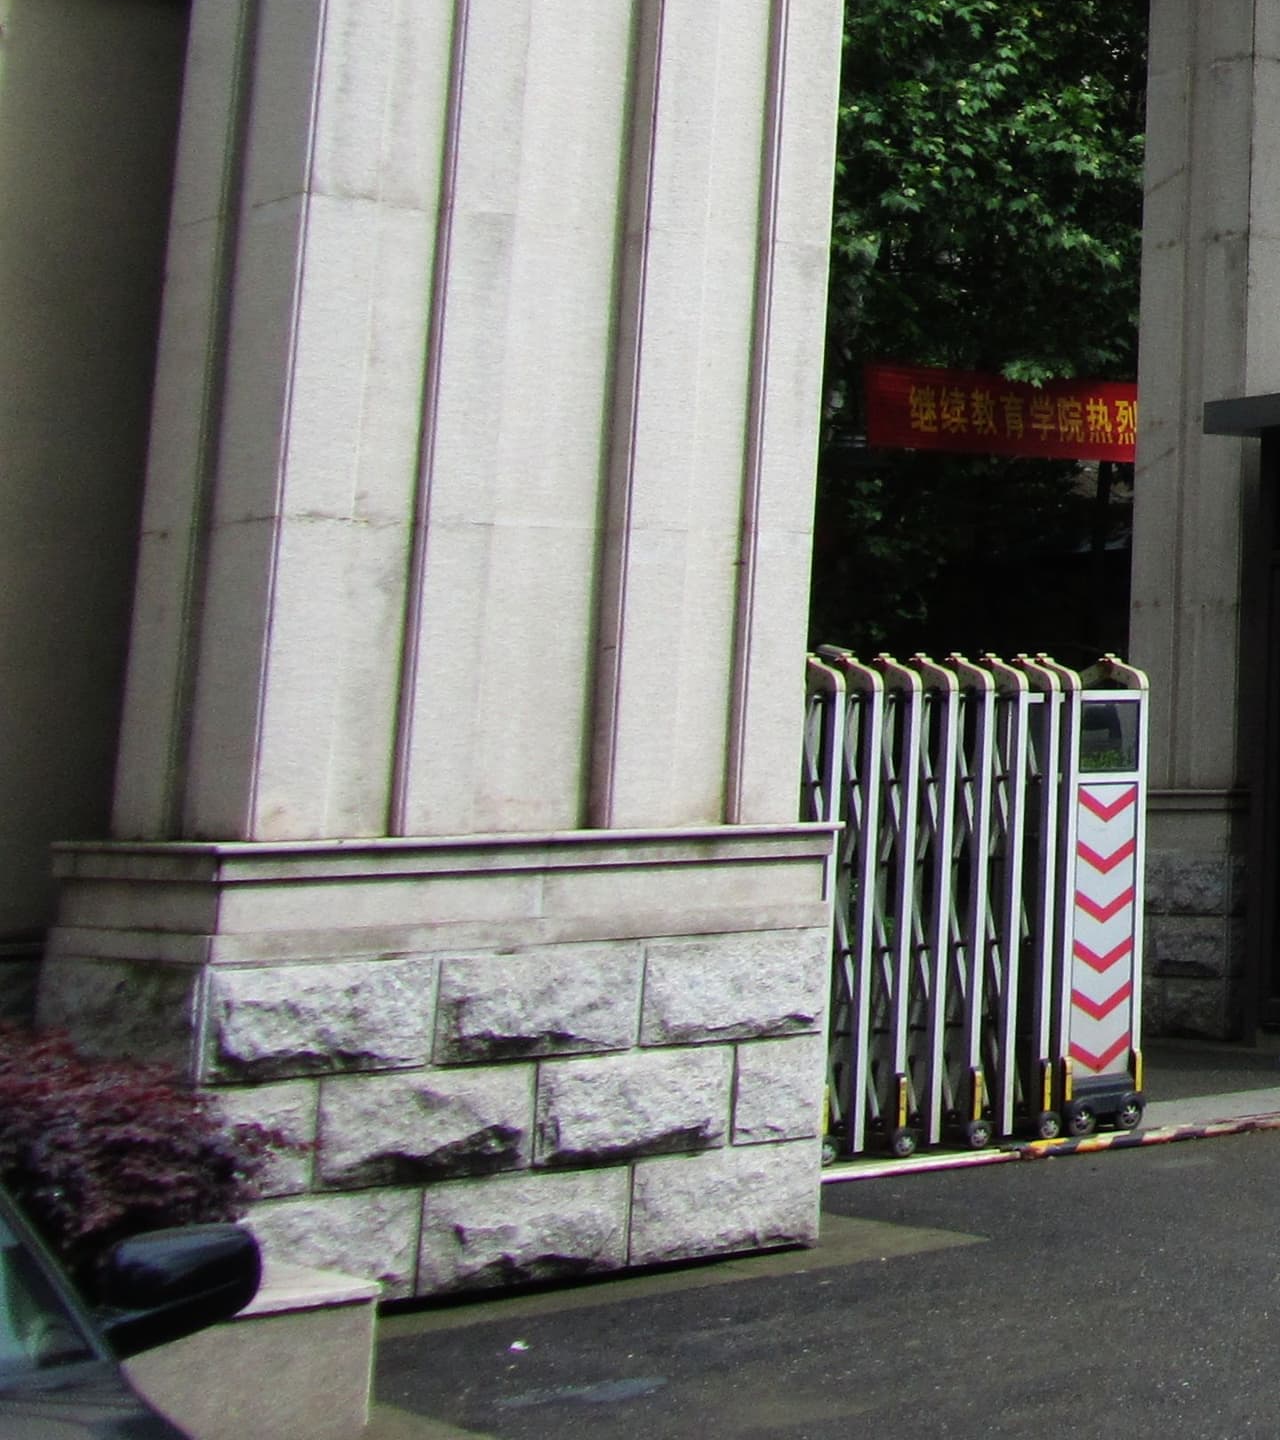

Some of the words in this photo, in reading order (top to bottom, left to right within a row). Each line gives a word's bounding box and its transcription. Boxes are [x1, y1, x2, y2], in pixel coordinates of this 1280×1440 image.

[909, 385, 1138, 445] 继续教育学院热烈
